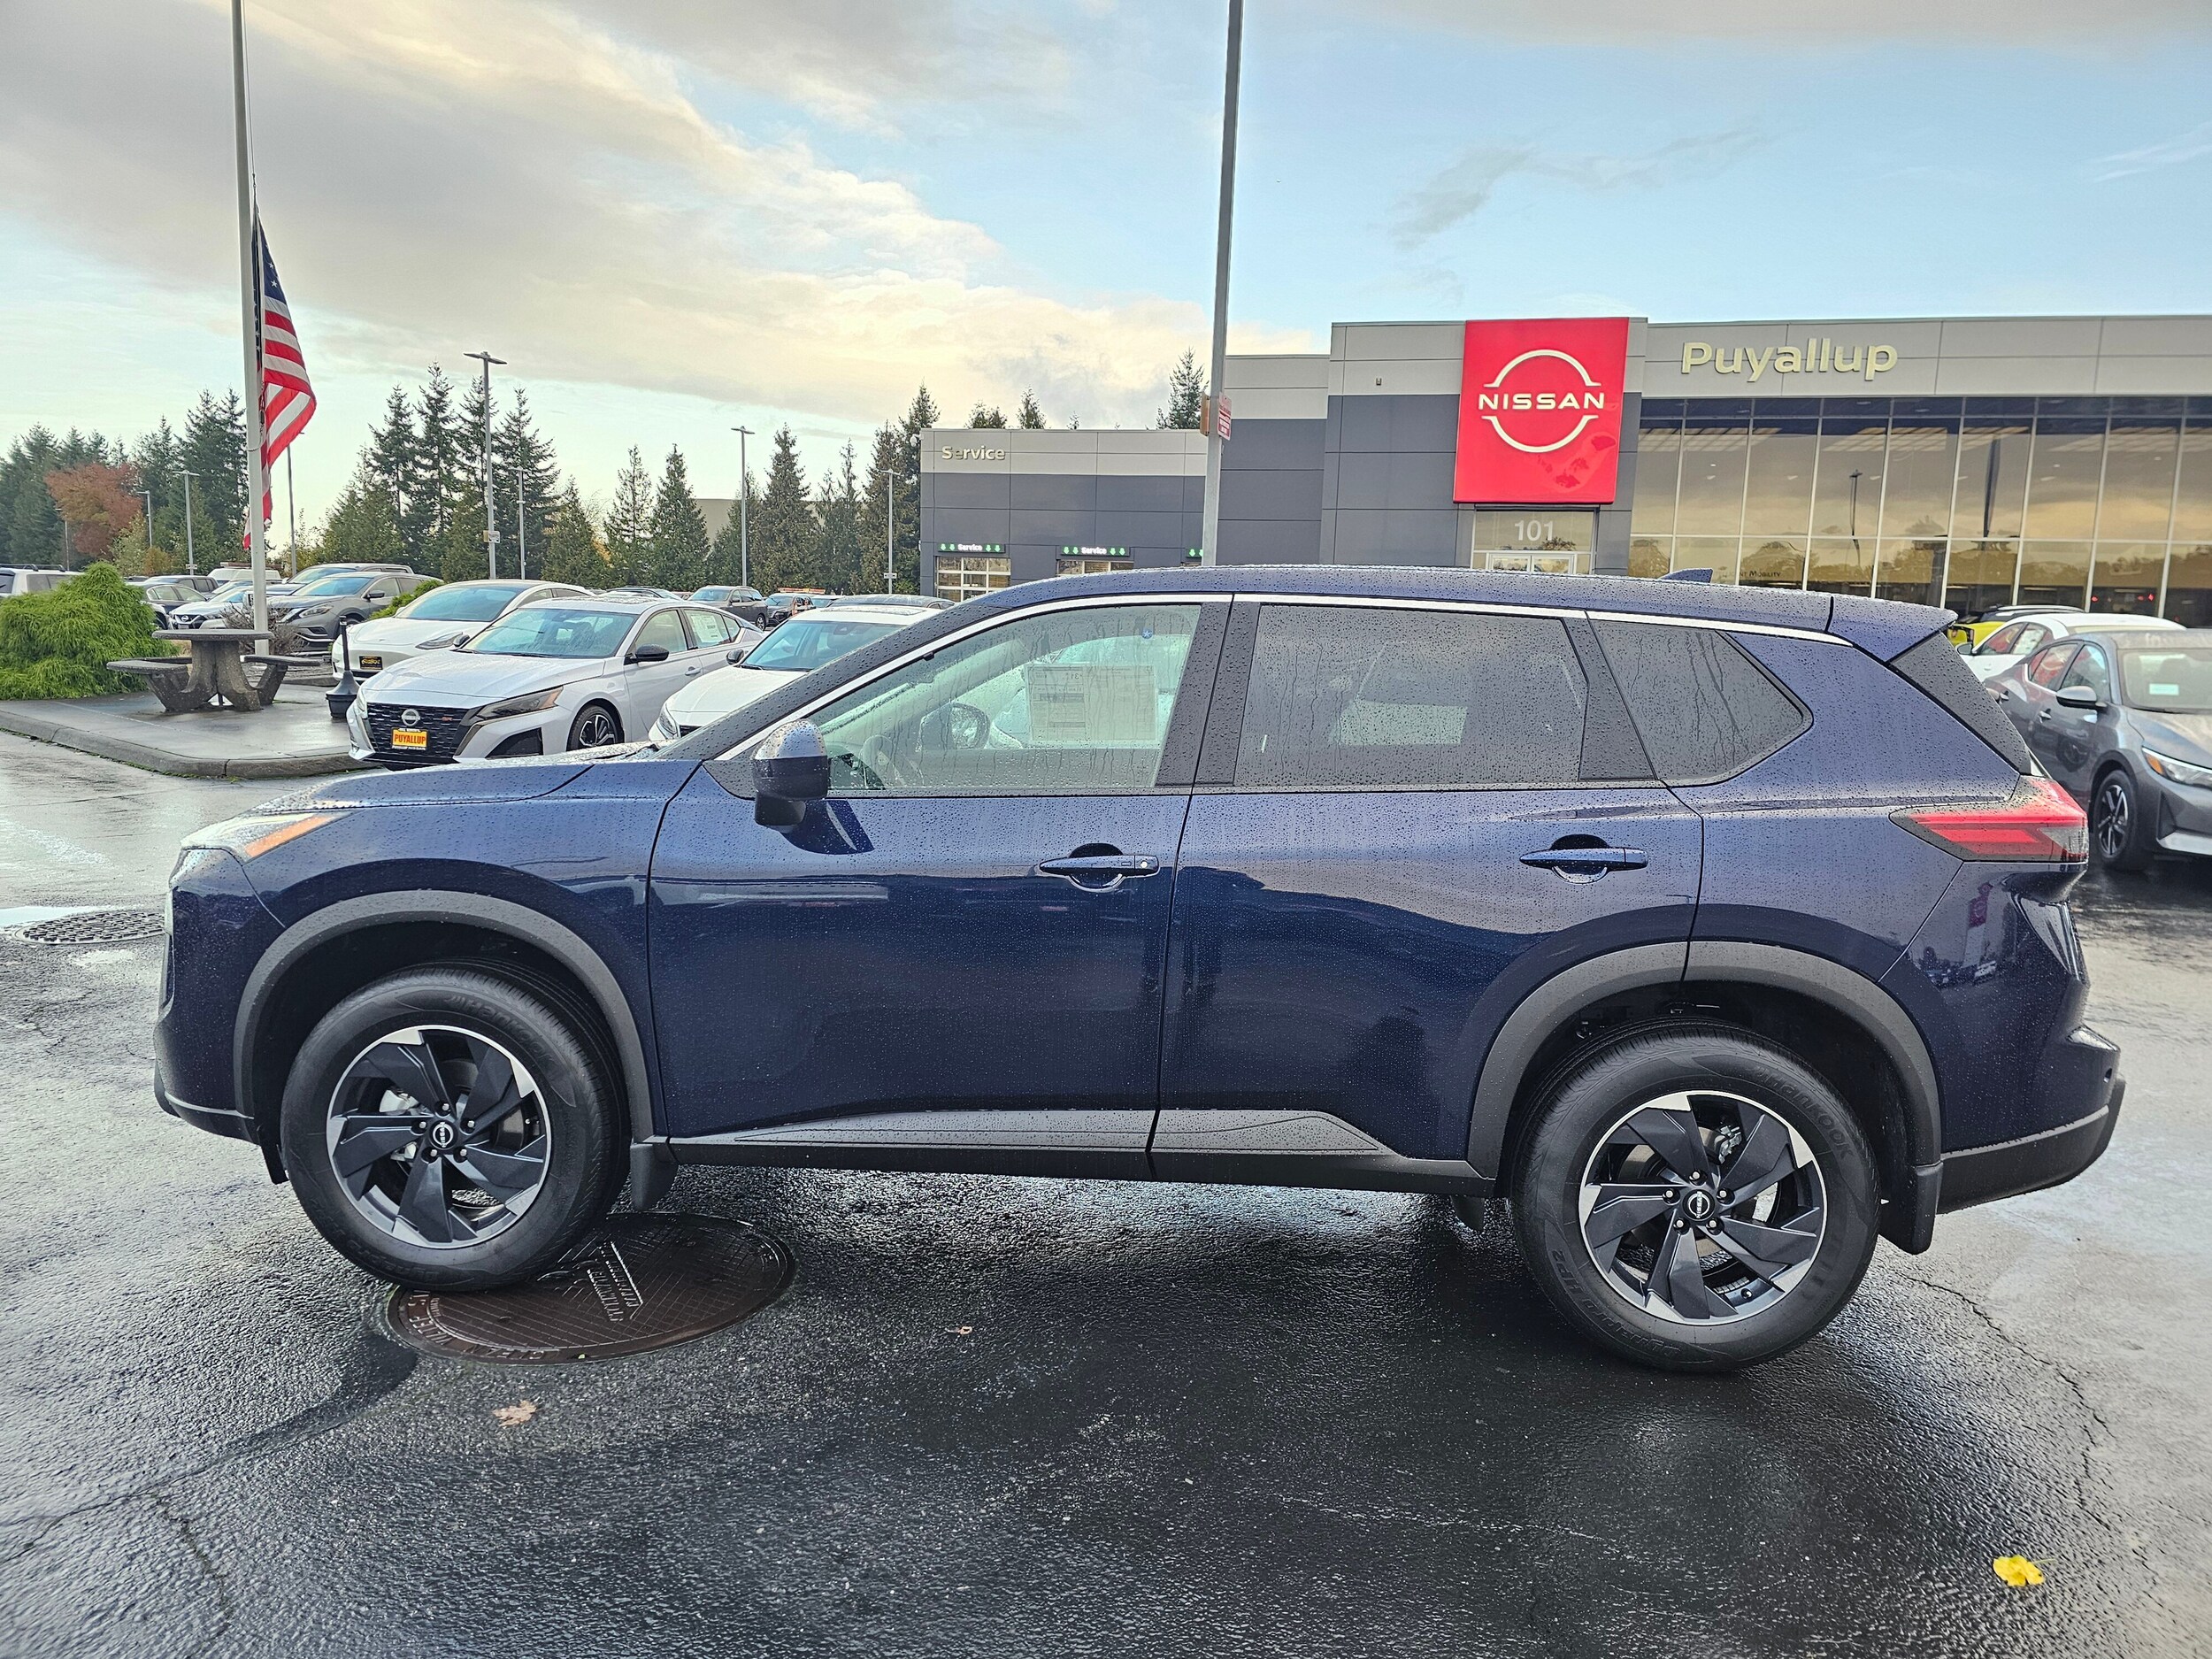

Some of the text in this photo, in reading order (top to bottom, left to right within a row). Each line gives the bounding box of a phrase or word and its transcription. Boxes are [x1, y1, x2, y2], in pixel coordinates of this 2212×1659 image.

[1681, 337, 1898, 382] Puyallup
[1478, 392, 1605, 410] NISSAN
[941, 445, 1005, 460] Service
[1514, 519, 1554, 541] 101
[394, 733, 426, 744] PUYALLUP
[1763, 1072, 1854, 1159] Hankook
